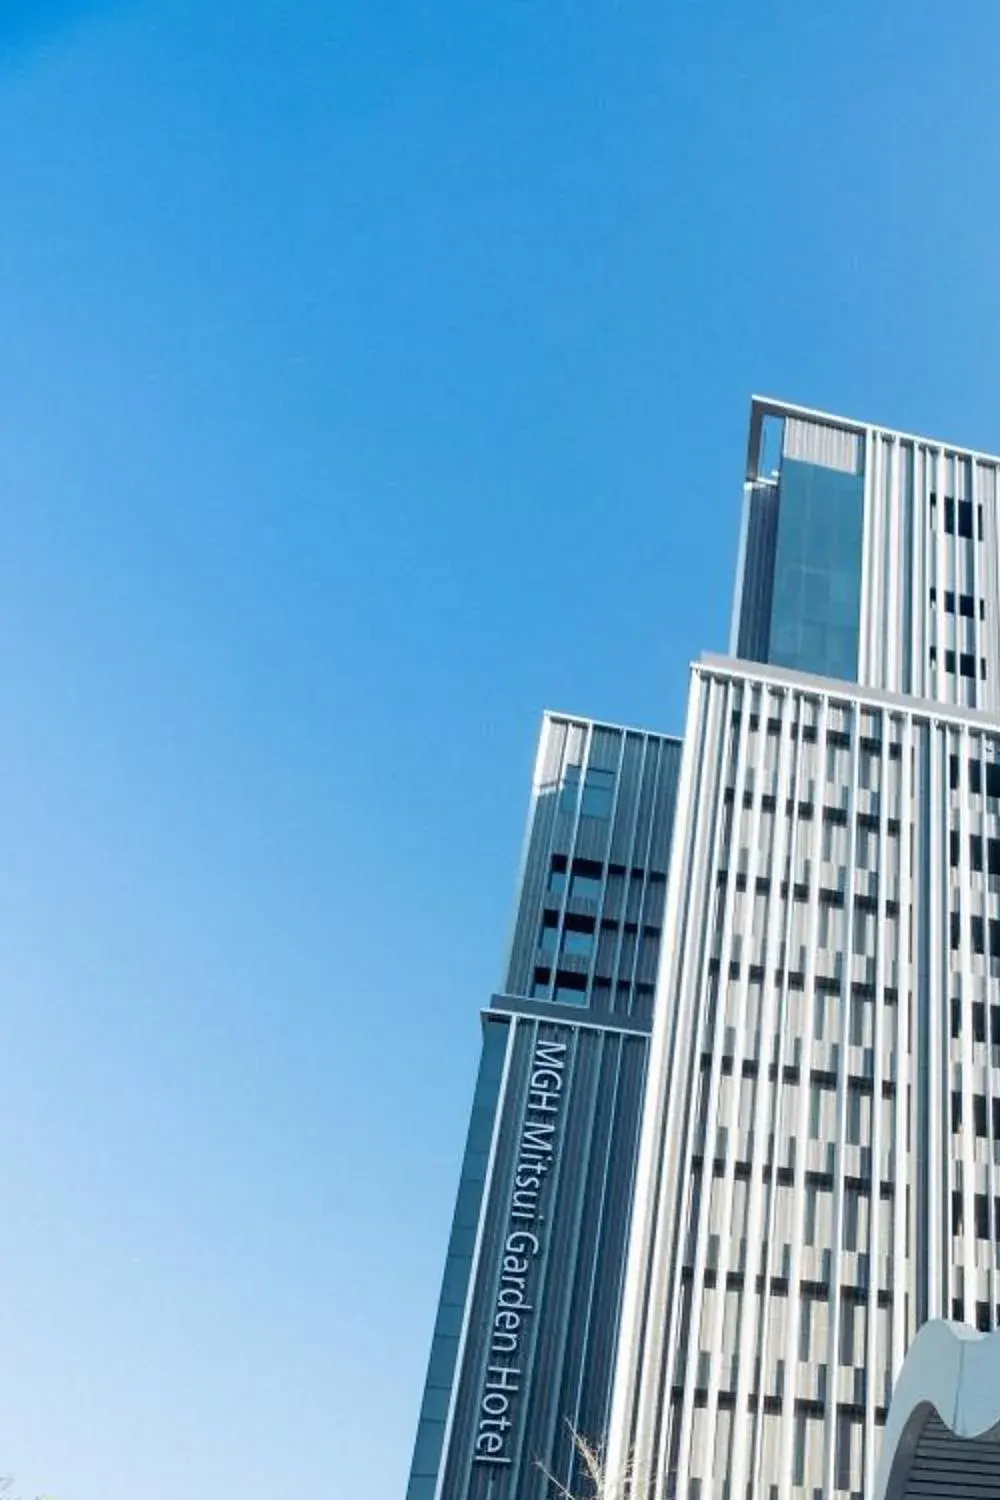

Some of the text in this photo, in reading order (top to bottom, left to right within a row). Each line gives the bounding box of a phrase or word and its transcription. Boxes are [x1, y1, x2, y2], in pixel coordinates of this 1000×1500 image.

[475, 1039, 567, 1464] MGH Mitsui Garden Hotel
